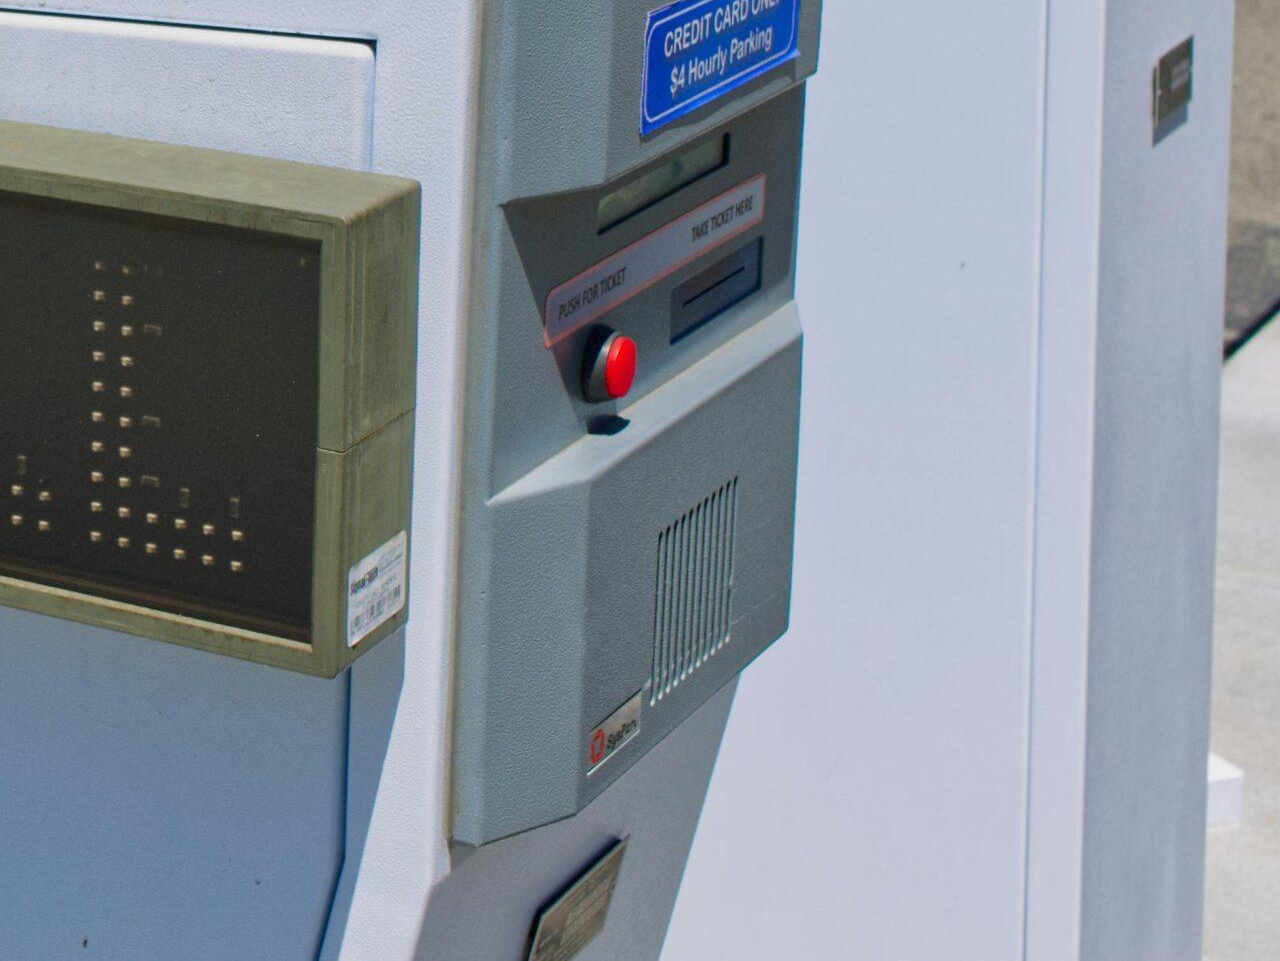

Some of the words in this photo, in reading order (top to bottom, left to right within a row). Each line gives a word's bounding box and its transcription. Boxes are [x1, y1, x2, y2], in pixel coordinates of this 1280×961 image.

[664, 12, 712, 57] CREDIT
[670, 64, 686, 99] $4
[688, 46, 727, 86] Hourly
[729, 26, 772, 65] Parking
[692, 219, 710, 242] TAKE
[710, 205, 734, 231] TICKET
[735, 195, 754, 218] HERE
[559, 294, 580, 321] PUSH
[582, 283, 599, 307] FOR
[600, 267, 626, 296] TICKET
